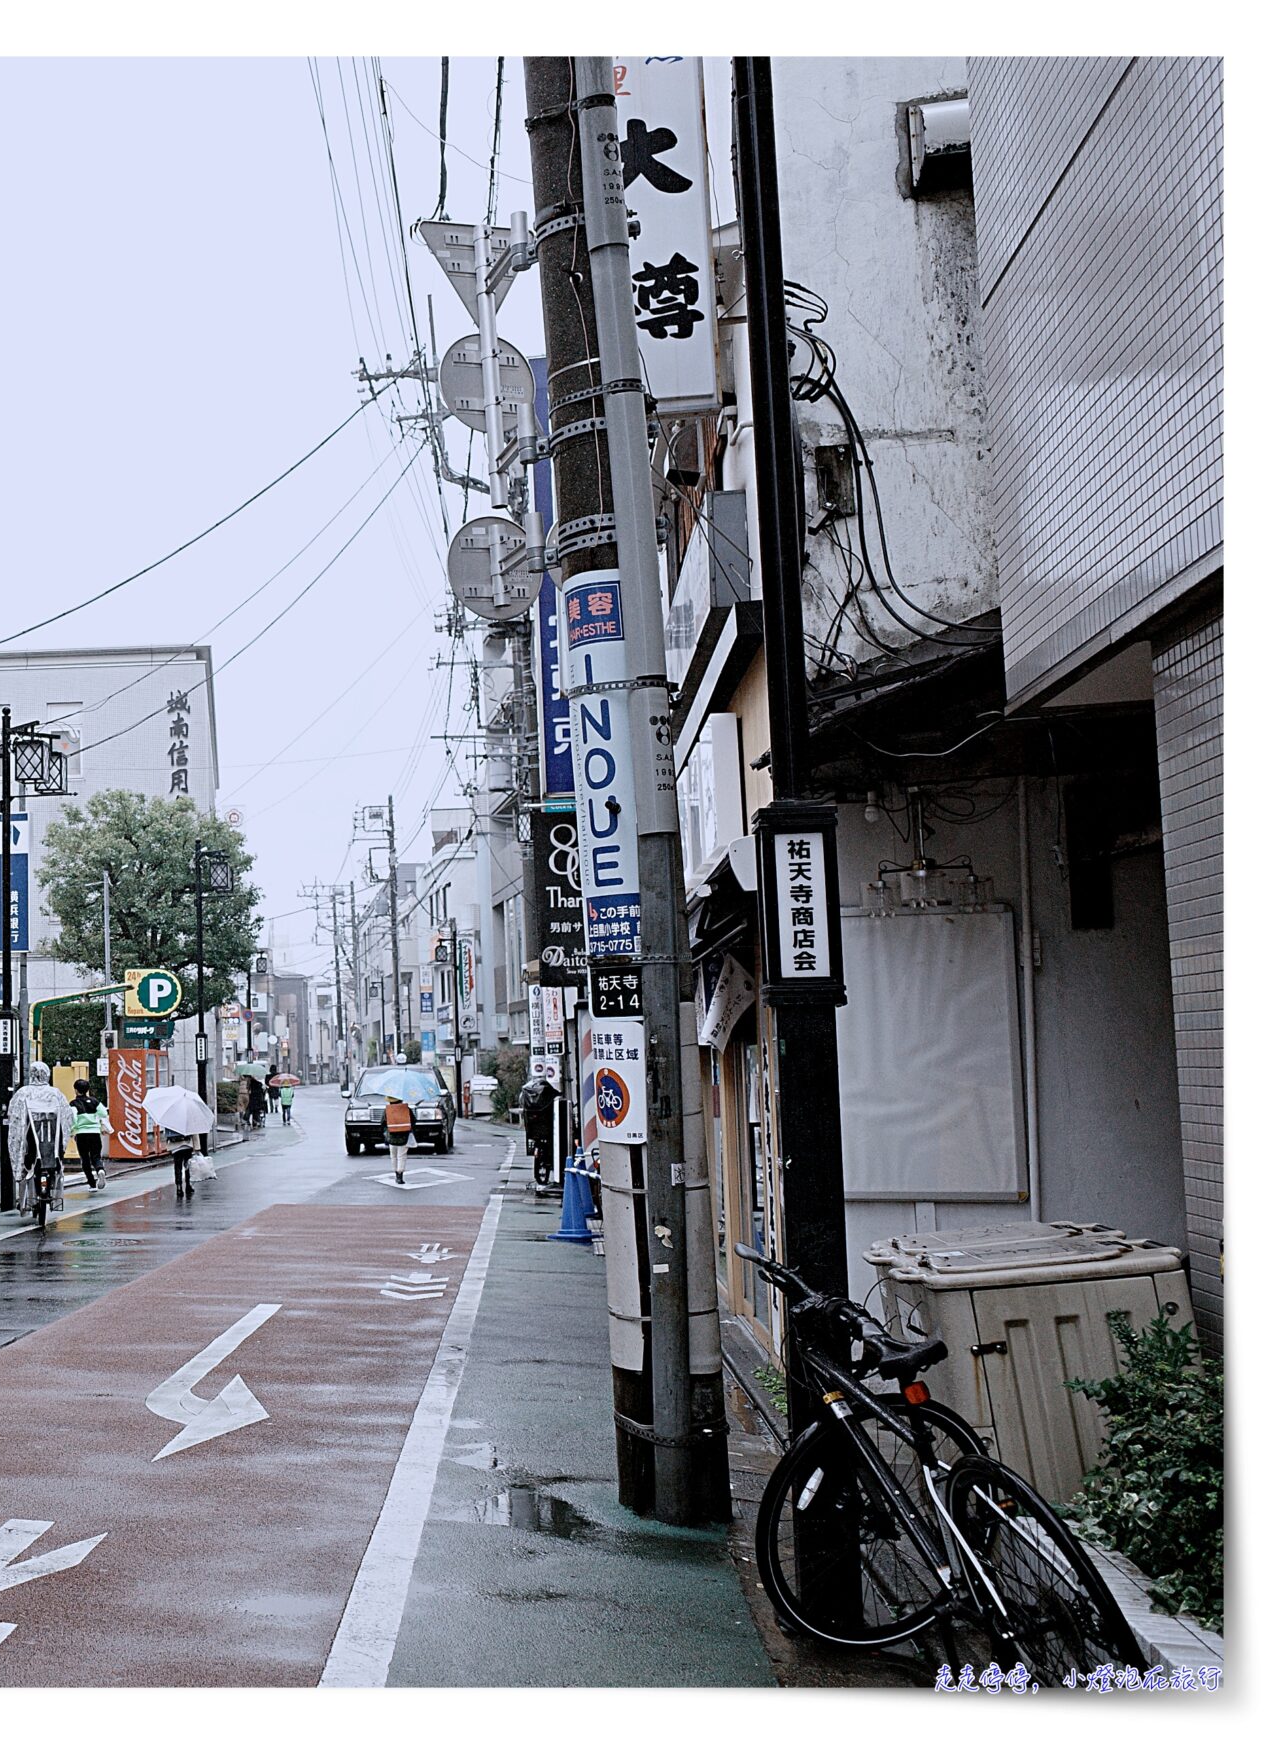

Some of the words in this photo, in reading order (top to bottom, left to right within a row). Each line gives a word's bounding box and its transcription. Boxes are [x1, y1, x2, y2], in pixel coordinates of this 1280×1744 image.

[569, 592, 613, 623] 美容
[167, 690, 190, 800] 城南信用
[579, 653, 624, 888] INOUE
[600, 905, 640, 919] この手前
[787, 840, 816, 972] 祐天寺商店会
[149, 979, 172, 1008] P
[599, 975, 638, 991] 祐天寺
[600, 995, 639, 1010] 2-14
